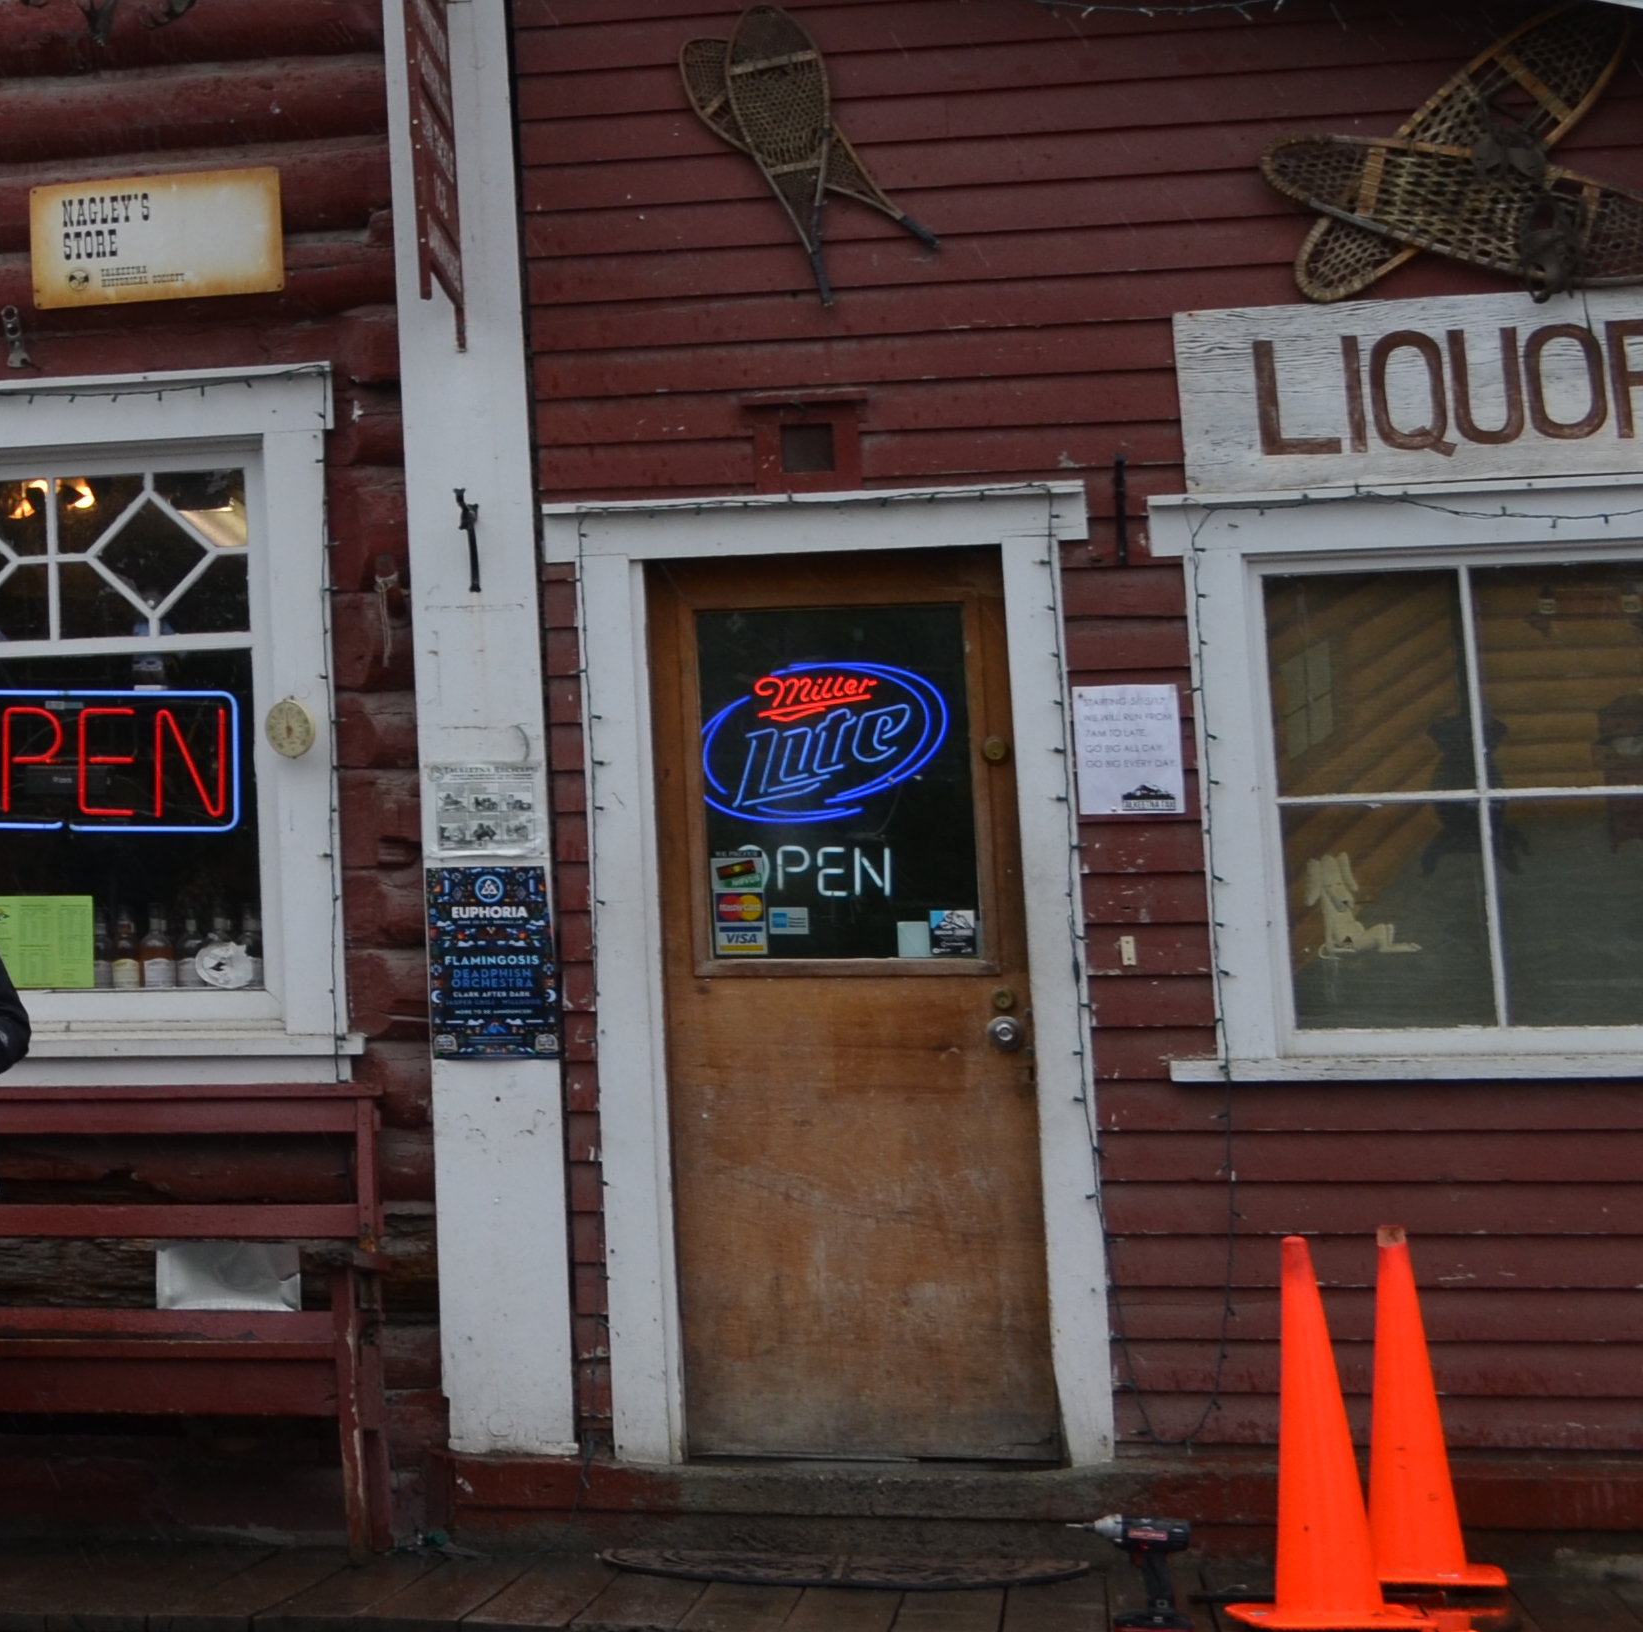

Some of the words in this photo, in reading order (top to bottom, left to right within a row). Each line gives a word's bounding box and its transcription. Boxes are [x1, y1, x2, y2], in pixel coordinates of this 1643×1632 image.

[62, 193, 150, 228] NAGLEY'S
[63, 229, 118, 261] STORE
[754, 676, 878, 709] Miller
[732, 703, 910, 808] Lite
[451, 906, 529, 918] EUPHORIA
[725, 933, 758, 944] VISA
[444, 955, 540, 966] FLAMINGOSIS
[453, 969, 532, 978] DEADPHISH
[451, 978, 534, 988] ORCHESTRA
